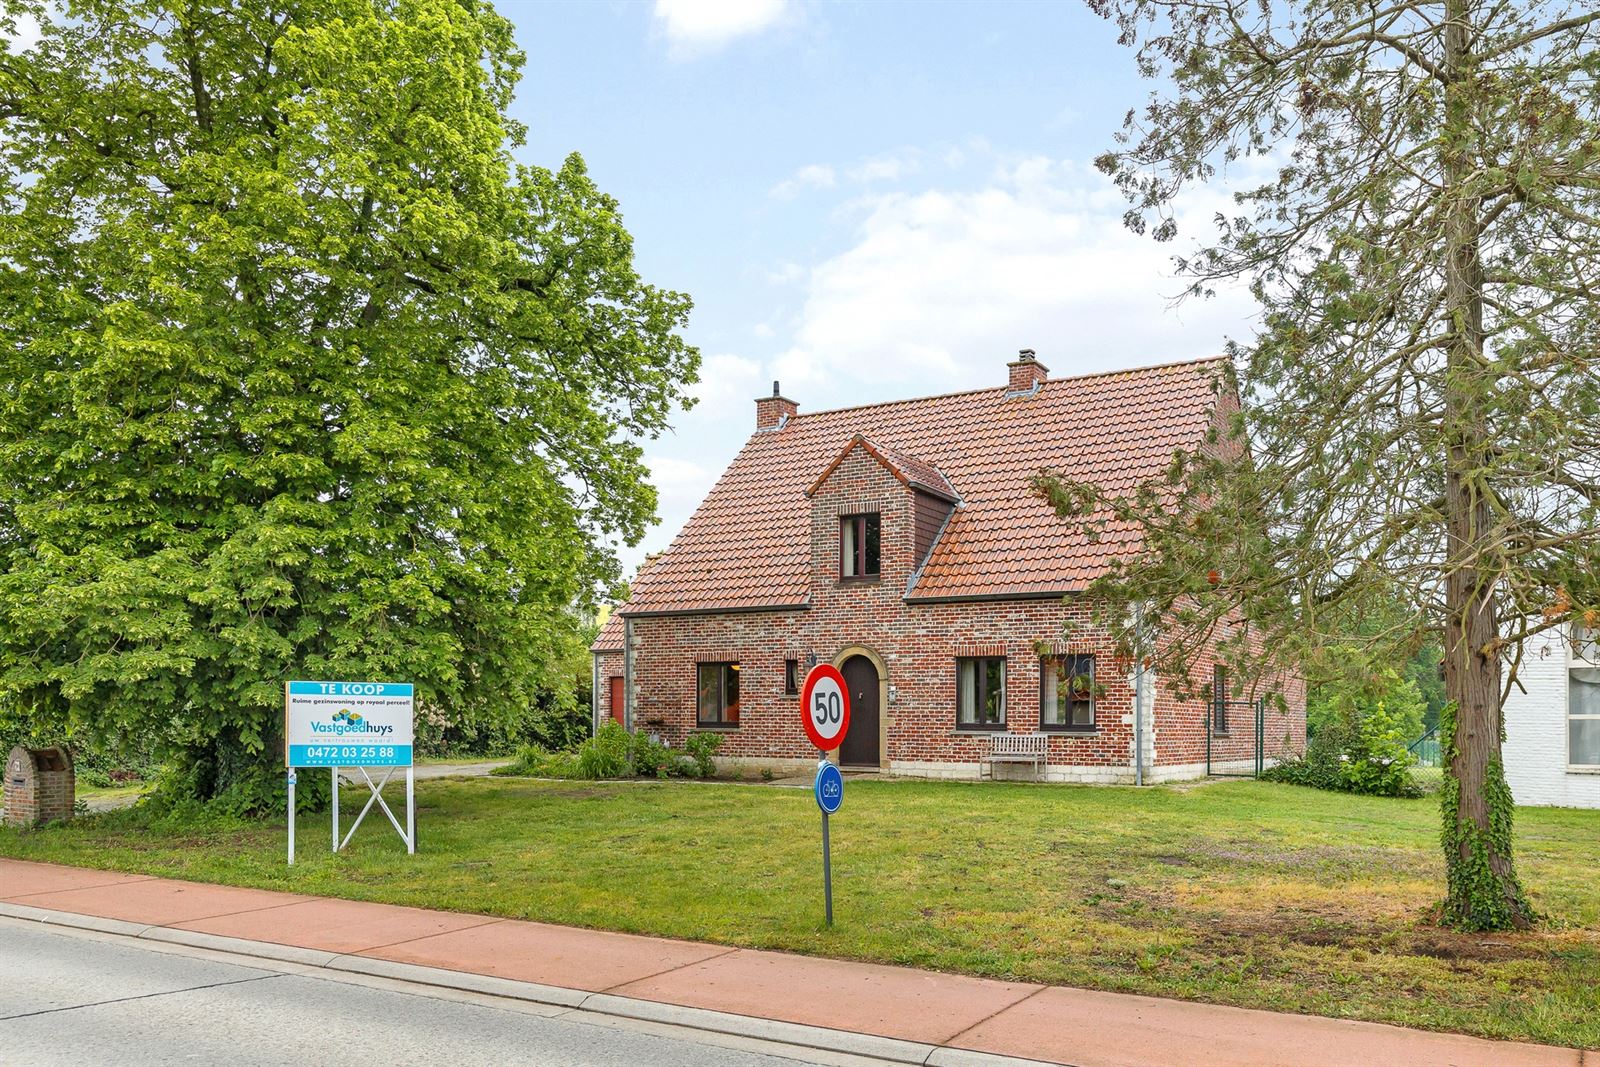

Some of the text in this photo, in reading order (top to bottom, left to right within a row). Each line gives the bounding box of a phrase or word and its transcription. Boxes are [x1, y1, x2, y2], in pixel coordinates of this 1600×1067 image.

[320, 683, 385, 695] TE KOOP
[313, 698, 355, 706] gezinswoning
[815, 691, 840, 725] 50
[310, 721, 393, 736] Vastgoedhuys
[307, 747, 394, 758] 0472 03 25 88
